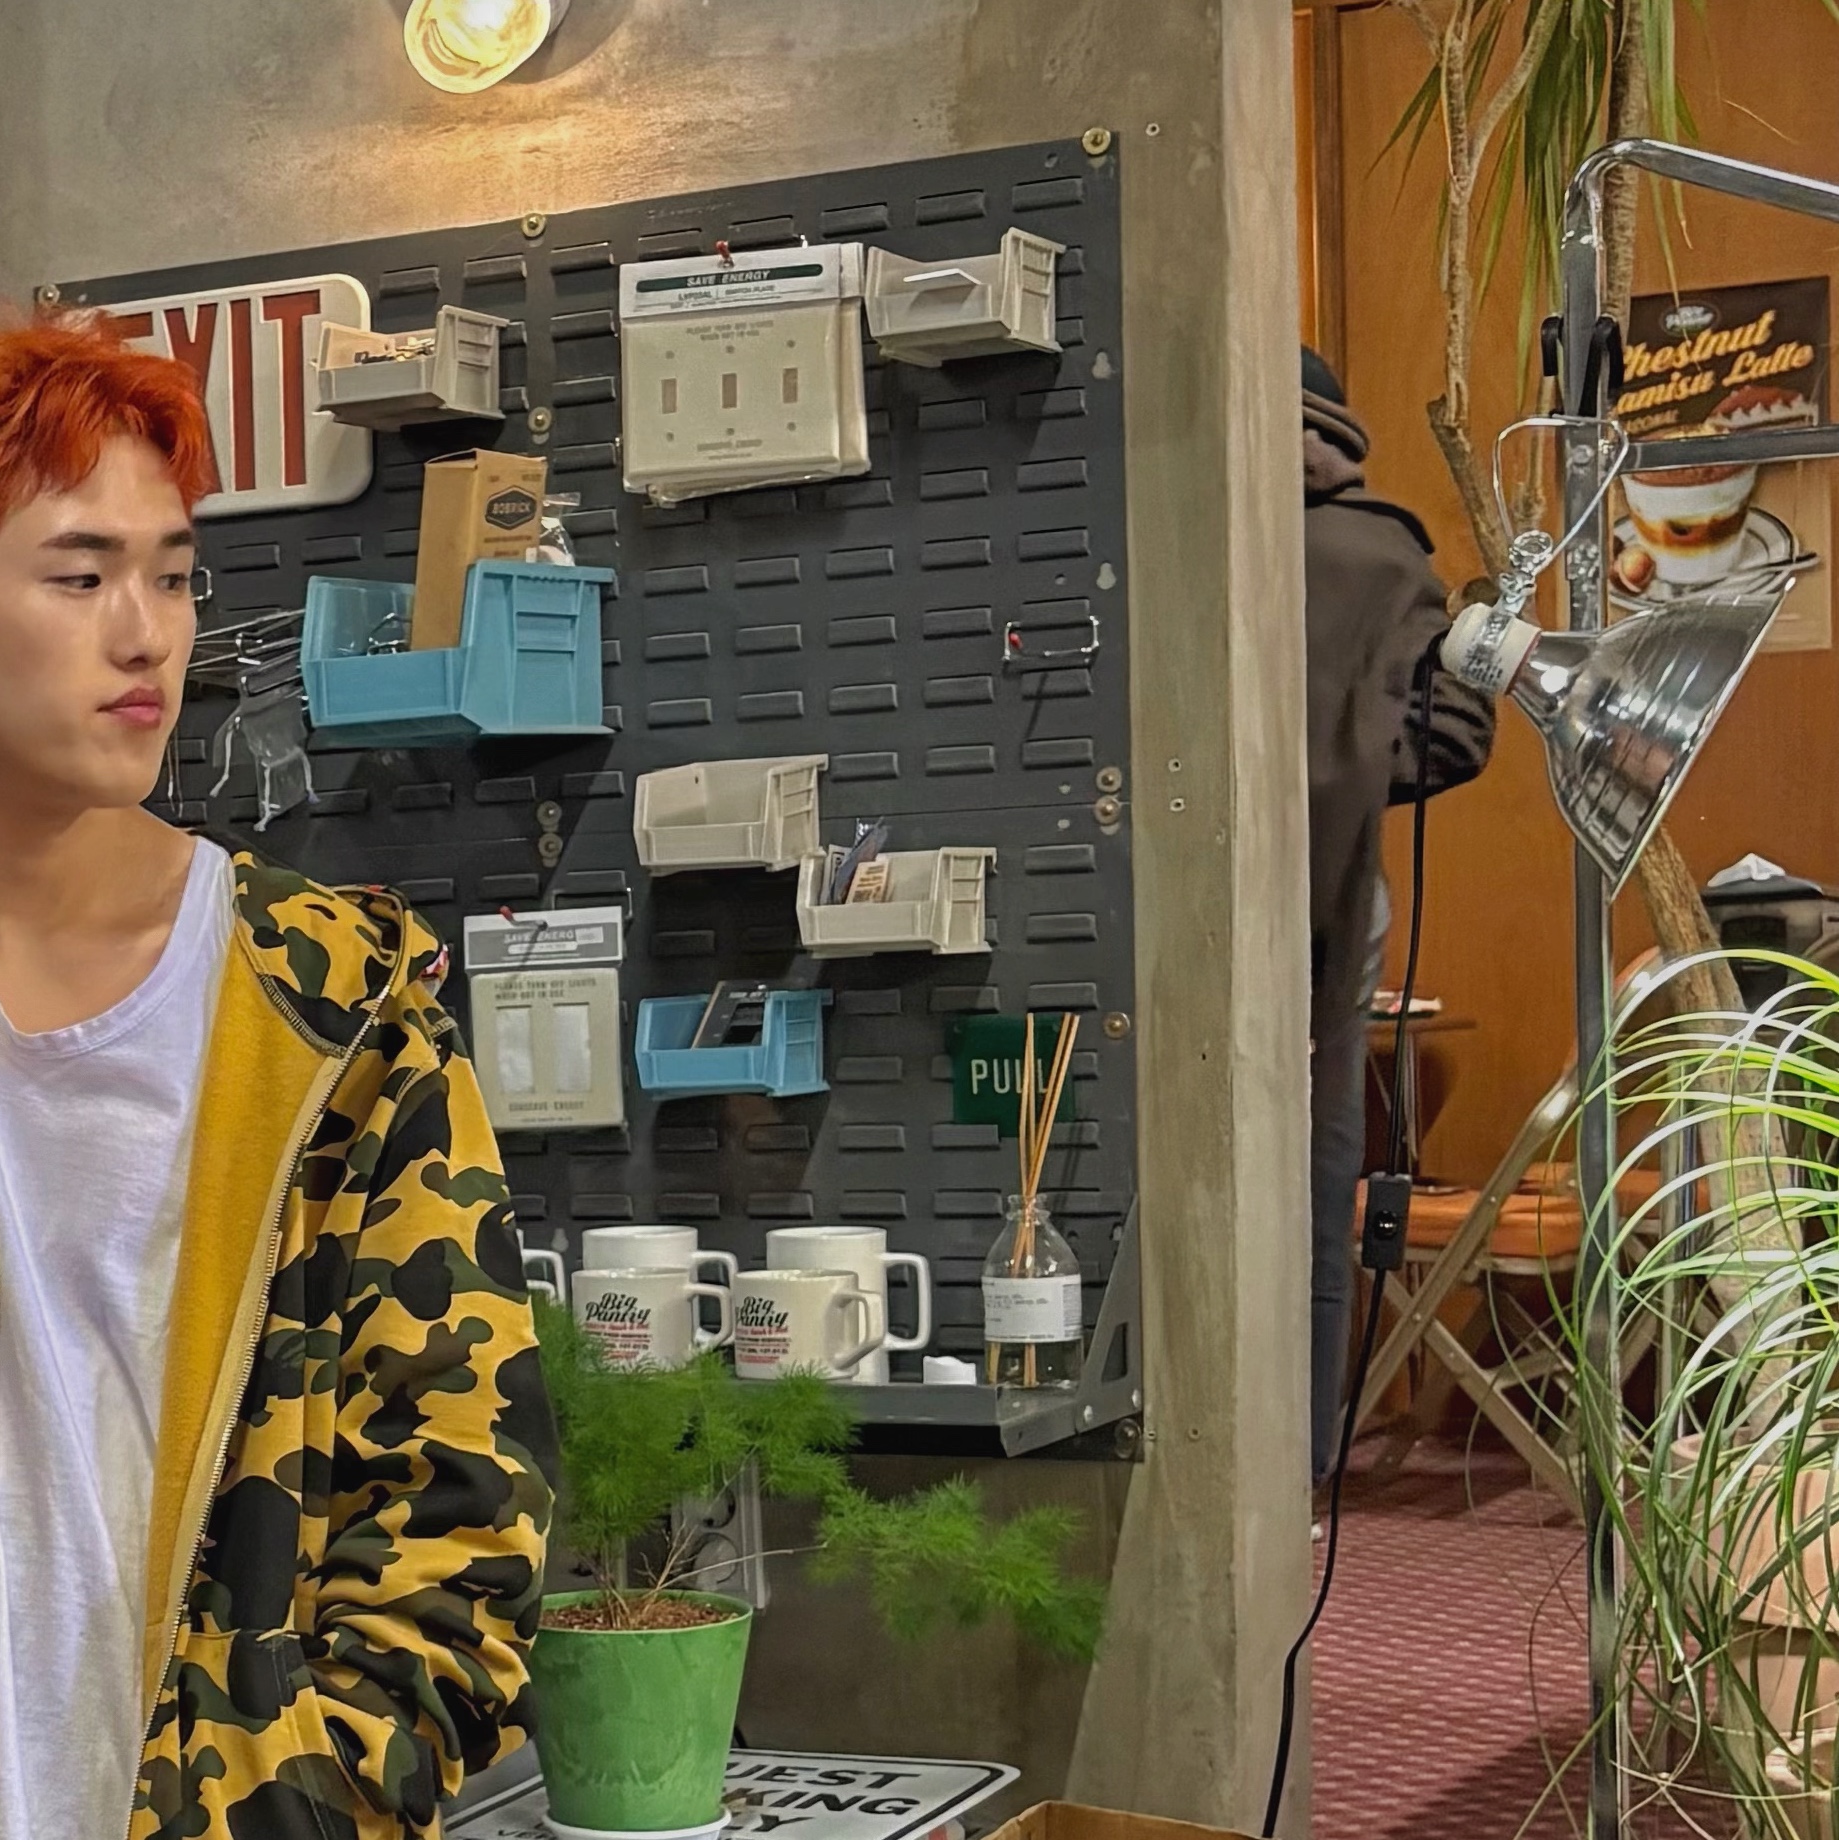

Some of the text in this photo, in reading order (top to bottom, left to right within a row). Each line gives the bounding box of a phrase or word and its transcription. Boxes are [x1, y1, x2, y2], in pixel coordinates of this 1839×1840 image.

[687, 270, 771, 287] SAVE ENERGY
[109, 289, 321, 495] XIT
[1616, 341, 1815, 414] amisu Latte
[537, 930, 575, 943] ENERG
[971, 1058, 1049, 1095] PULL
[725, 1762, 921, 1790] UEST
[722, 1787, 921, 1816] KING
